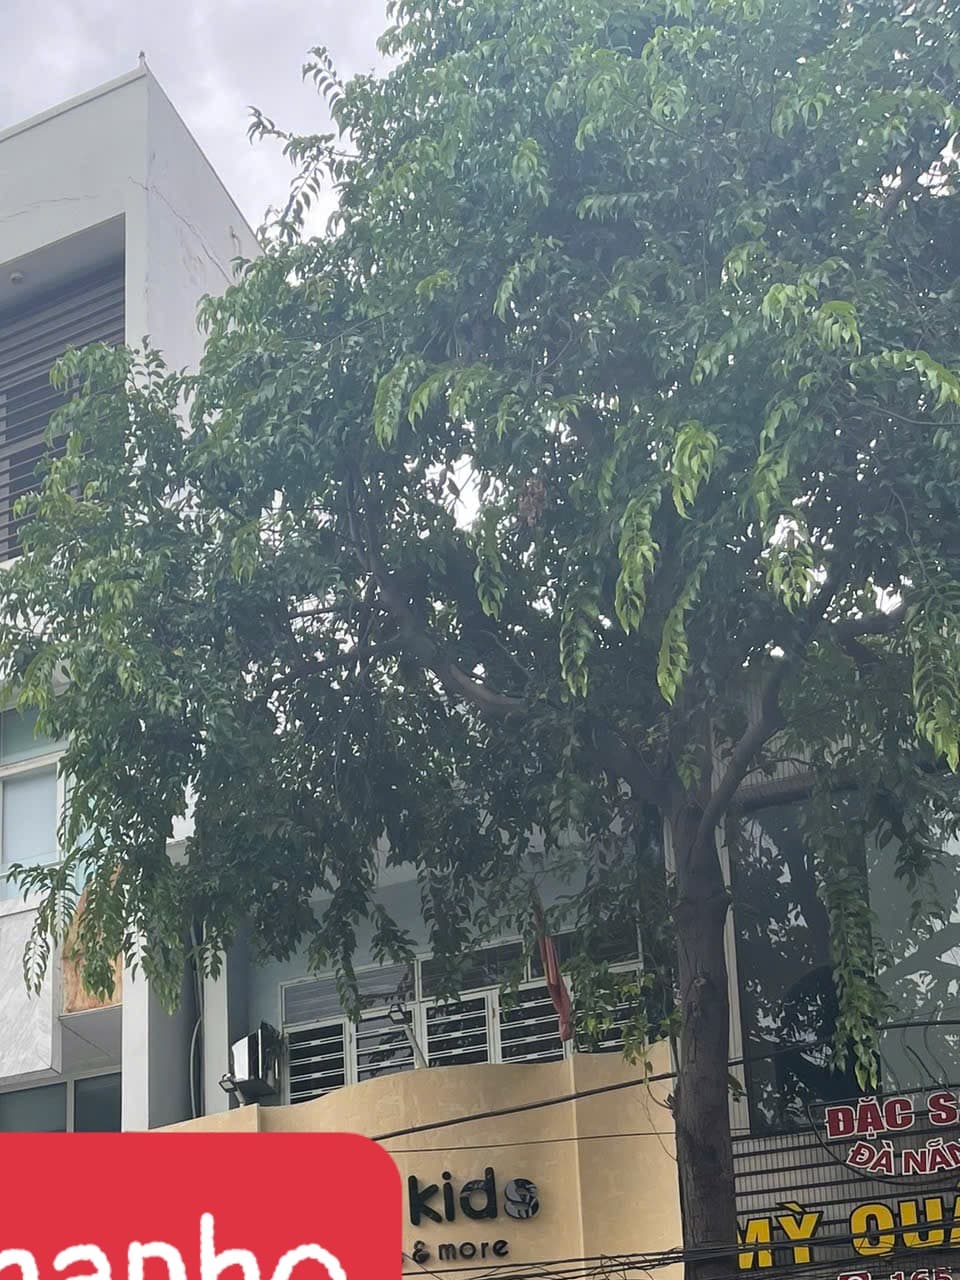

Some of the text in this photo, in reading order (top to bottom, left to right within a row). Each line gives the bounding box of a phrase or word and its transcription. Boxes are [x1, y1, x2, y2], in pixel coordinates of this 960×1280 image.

[824, 1091, 960, 1139] ĐẶC S
[846, 1140, 895, 1175] ĐÀ
[407, 1166, 540, 1226] kids
[850, 1196, 960, 1257] QU
[412, 1240, 509, 1264] & more
